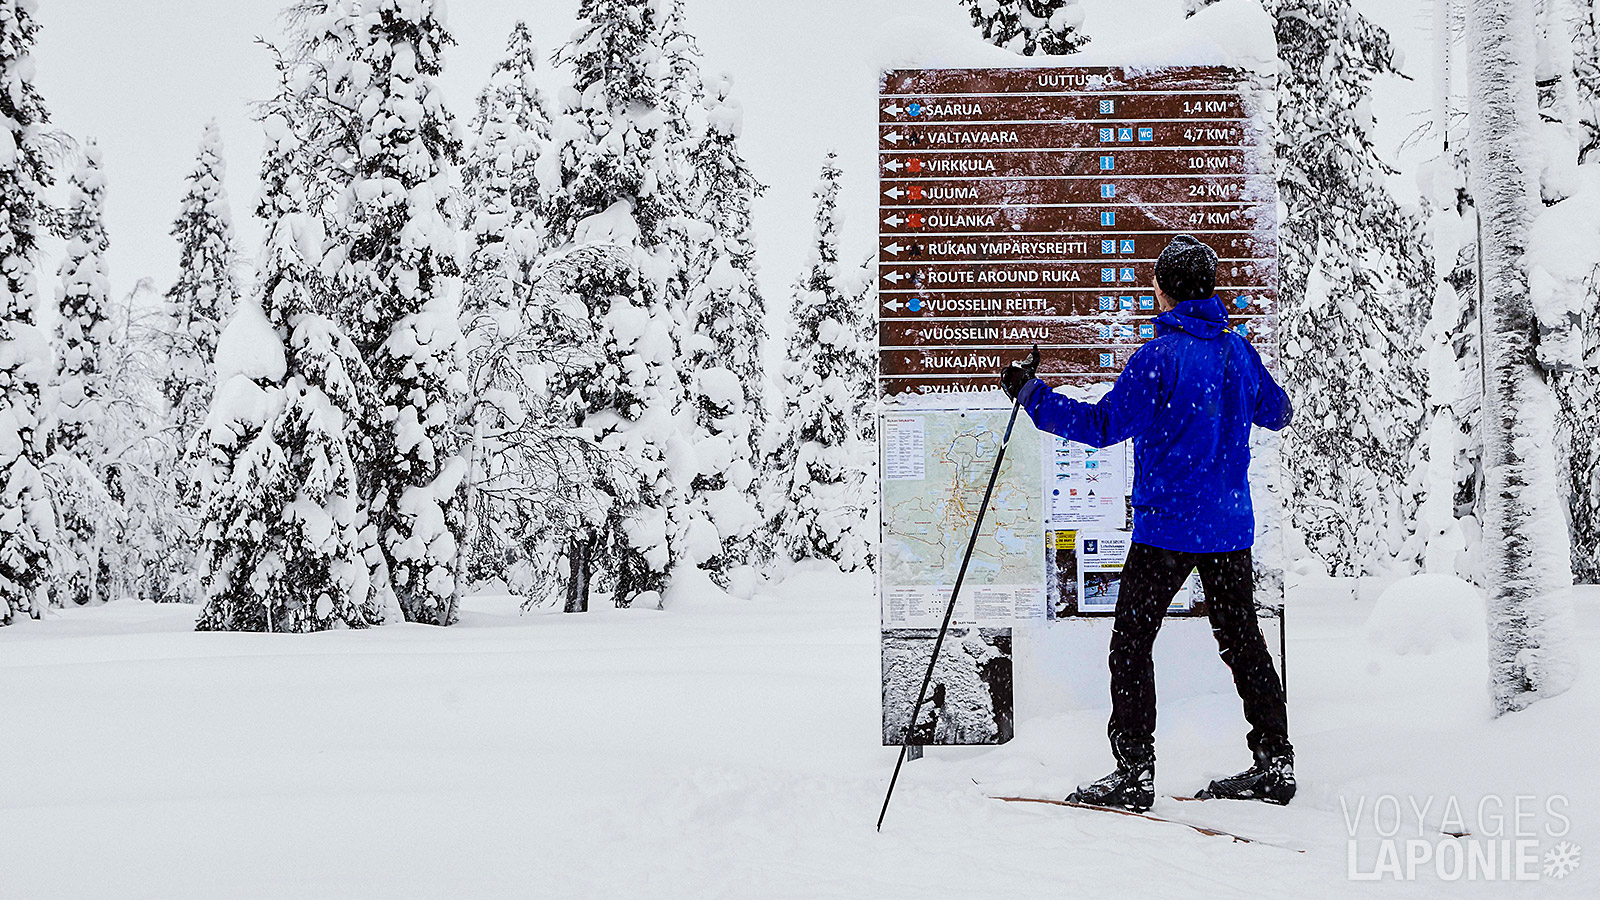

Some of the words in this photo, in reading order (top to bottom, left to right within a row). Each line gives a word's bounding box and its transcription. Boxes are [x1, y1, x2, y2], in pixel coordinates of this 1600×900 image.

[926, 104, 983, 116] SAARUA
[1183, 102, 1202, 113] 1,4
[1205, 101, 1227, 112] KM
[927, 131, 1019, 143] VALTAVAARA
[1184, 129, 1203, 141] 4,7
[1206, 129, 1228, 140] KM
[927, 159, 995, 171] VIRKKULA
[1189, 158, 1204, 169] 10
[1206, 157, 1228, 168] KM
[927, 187, 979, 199] JUUMA
[1189, 185, 1205, 196] 24
[1208, 185, 1230, 196] KM
[928, 215, 995, 227] OULANKA
[1189, 213, 1205, 224] 47
[1208, 213, 1230, 224] KM
[929, 243, 976, 255] RUKAN
[980, 240, 1087, 254] YMPÄRYSREITTI
[929, 271, 974, 283] ROUTE
[977, 271, 1038, 282] AROUND
[1042, 270, 1080, 282] RUKA
[927, 299, 1001, 311] VUOSSELIN
[1006, 298, 1047, 310] REITTI
[923, 328, 999, 340] VUOSSELIN
[1003, 328, 1049, 339] LAAVU
[925, 353, 1000, 368] RUKAJÄRVI
[924, 382, 999, 394] PYHÄVAAR
